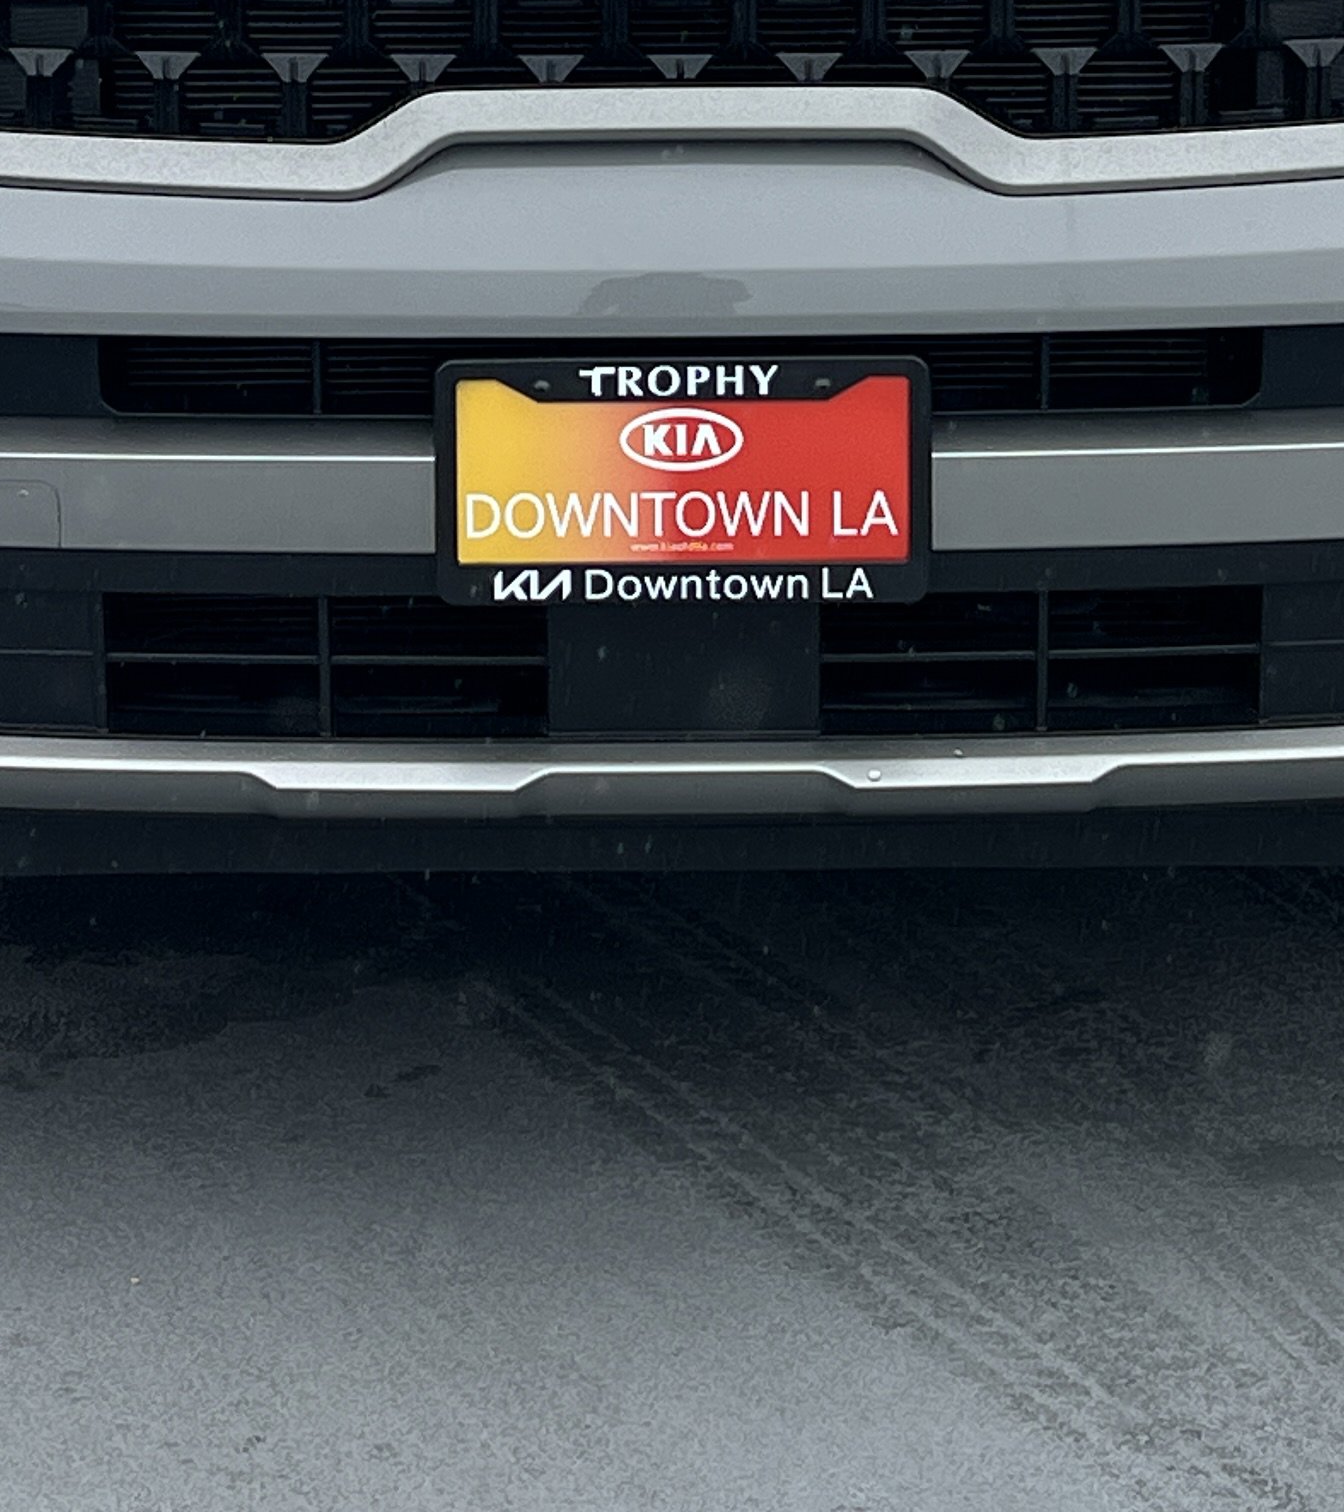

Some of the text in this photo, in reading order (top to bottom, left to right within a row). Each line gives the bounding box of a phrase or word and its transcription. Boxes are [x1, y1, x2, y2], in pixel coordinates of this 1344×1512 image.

[578, 365, 779, 397] TROPHY
[641, 423, 723, 456] KIA
[465, 490, 899, 540] DOWNTOWN LA
[493, 567, 874, 601] KIA Downtown LA
